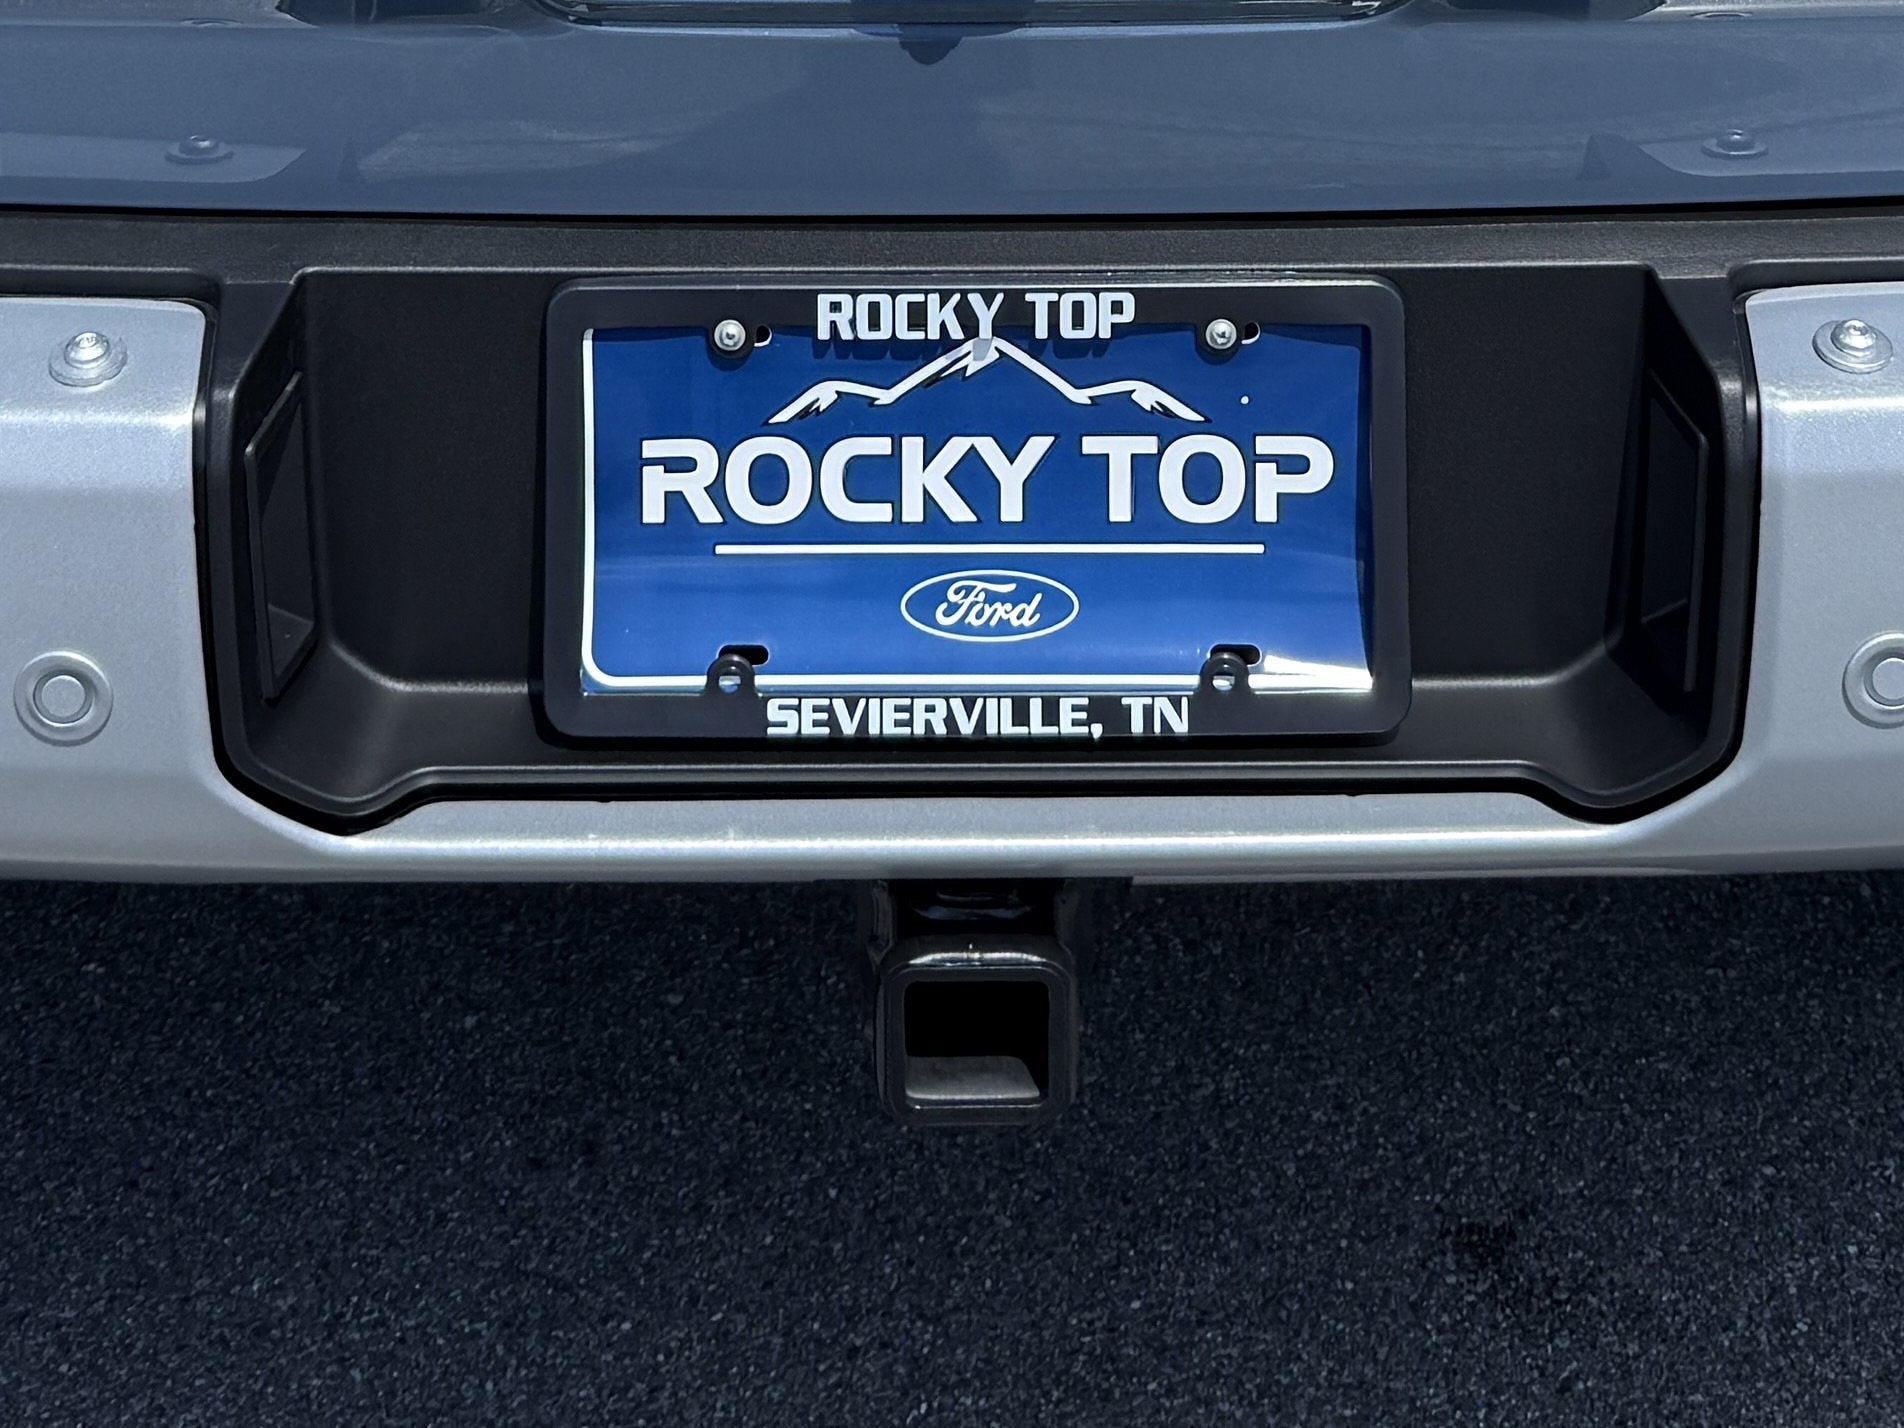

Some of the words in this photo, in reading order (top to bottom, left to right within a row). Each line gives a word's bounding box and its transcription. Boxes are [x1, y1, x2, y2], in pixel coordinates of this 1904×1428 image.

[816, 291, 1005, 341] ROCKY
[1024, 291, 1136, 340] TOP
[639, 434, 1057, 526] ROCKY
[1080, 432, 1336, 525] TOP
[934, 579, 1043, 628] Ford
[765, 696, 1104, 740] SEVIERVILLE,
[1120, 695, 1190, 734] TN
